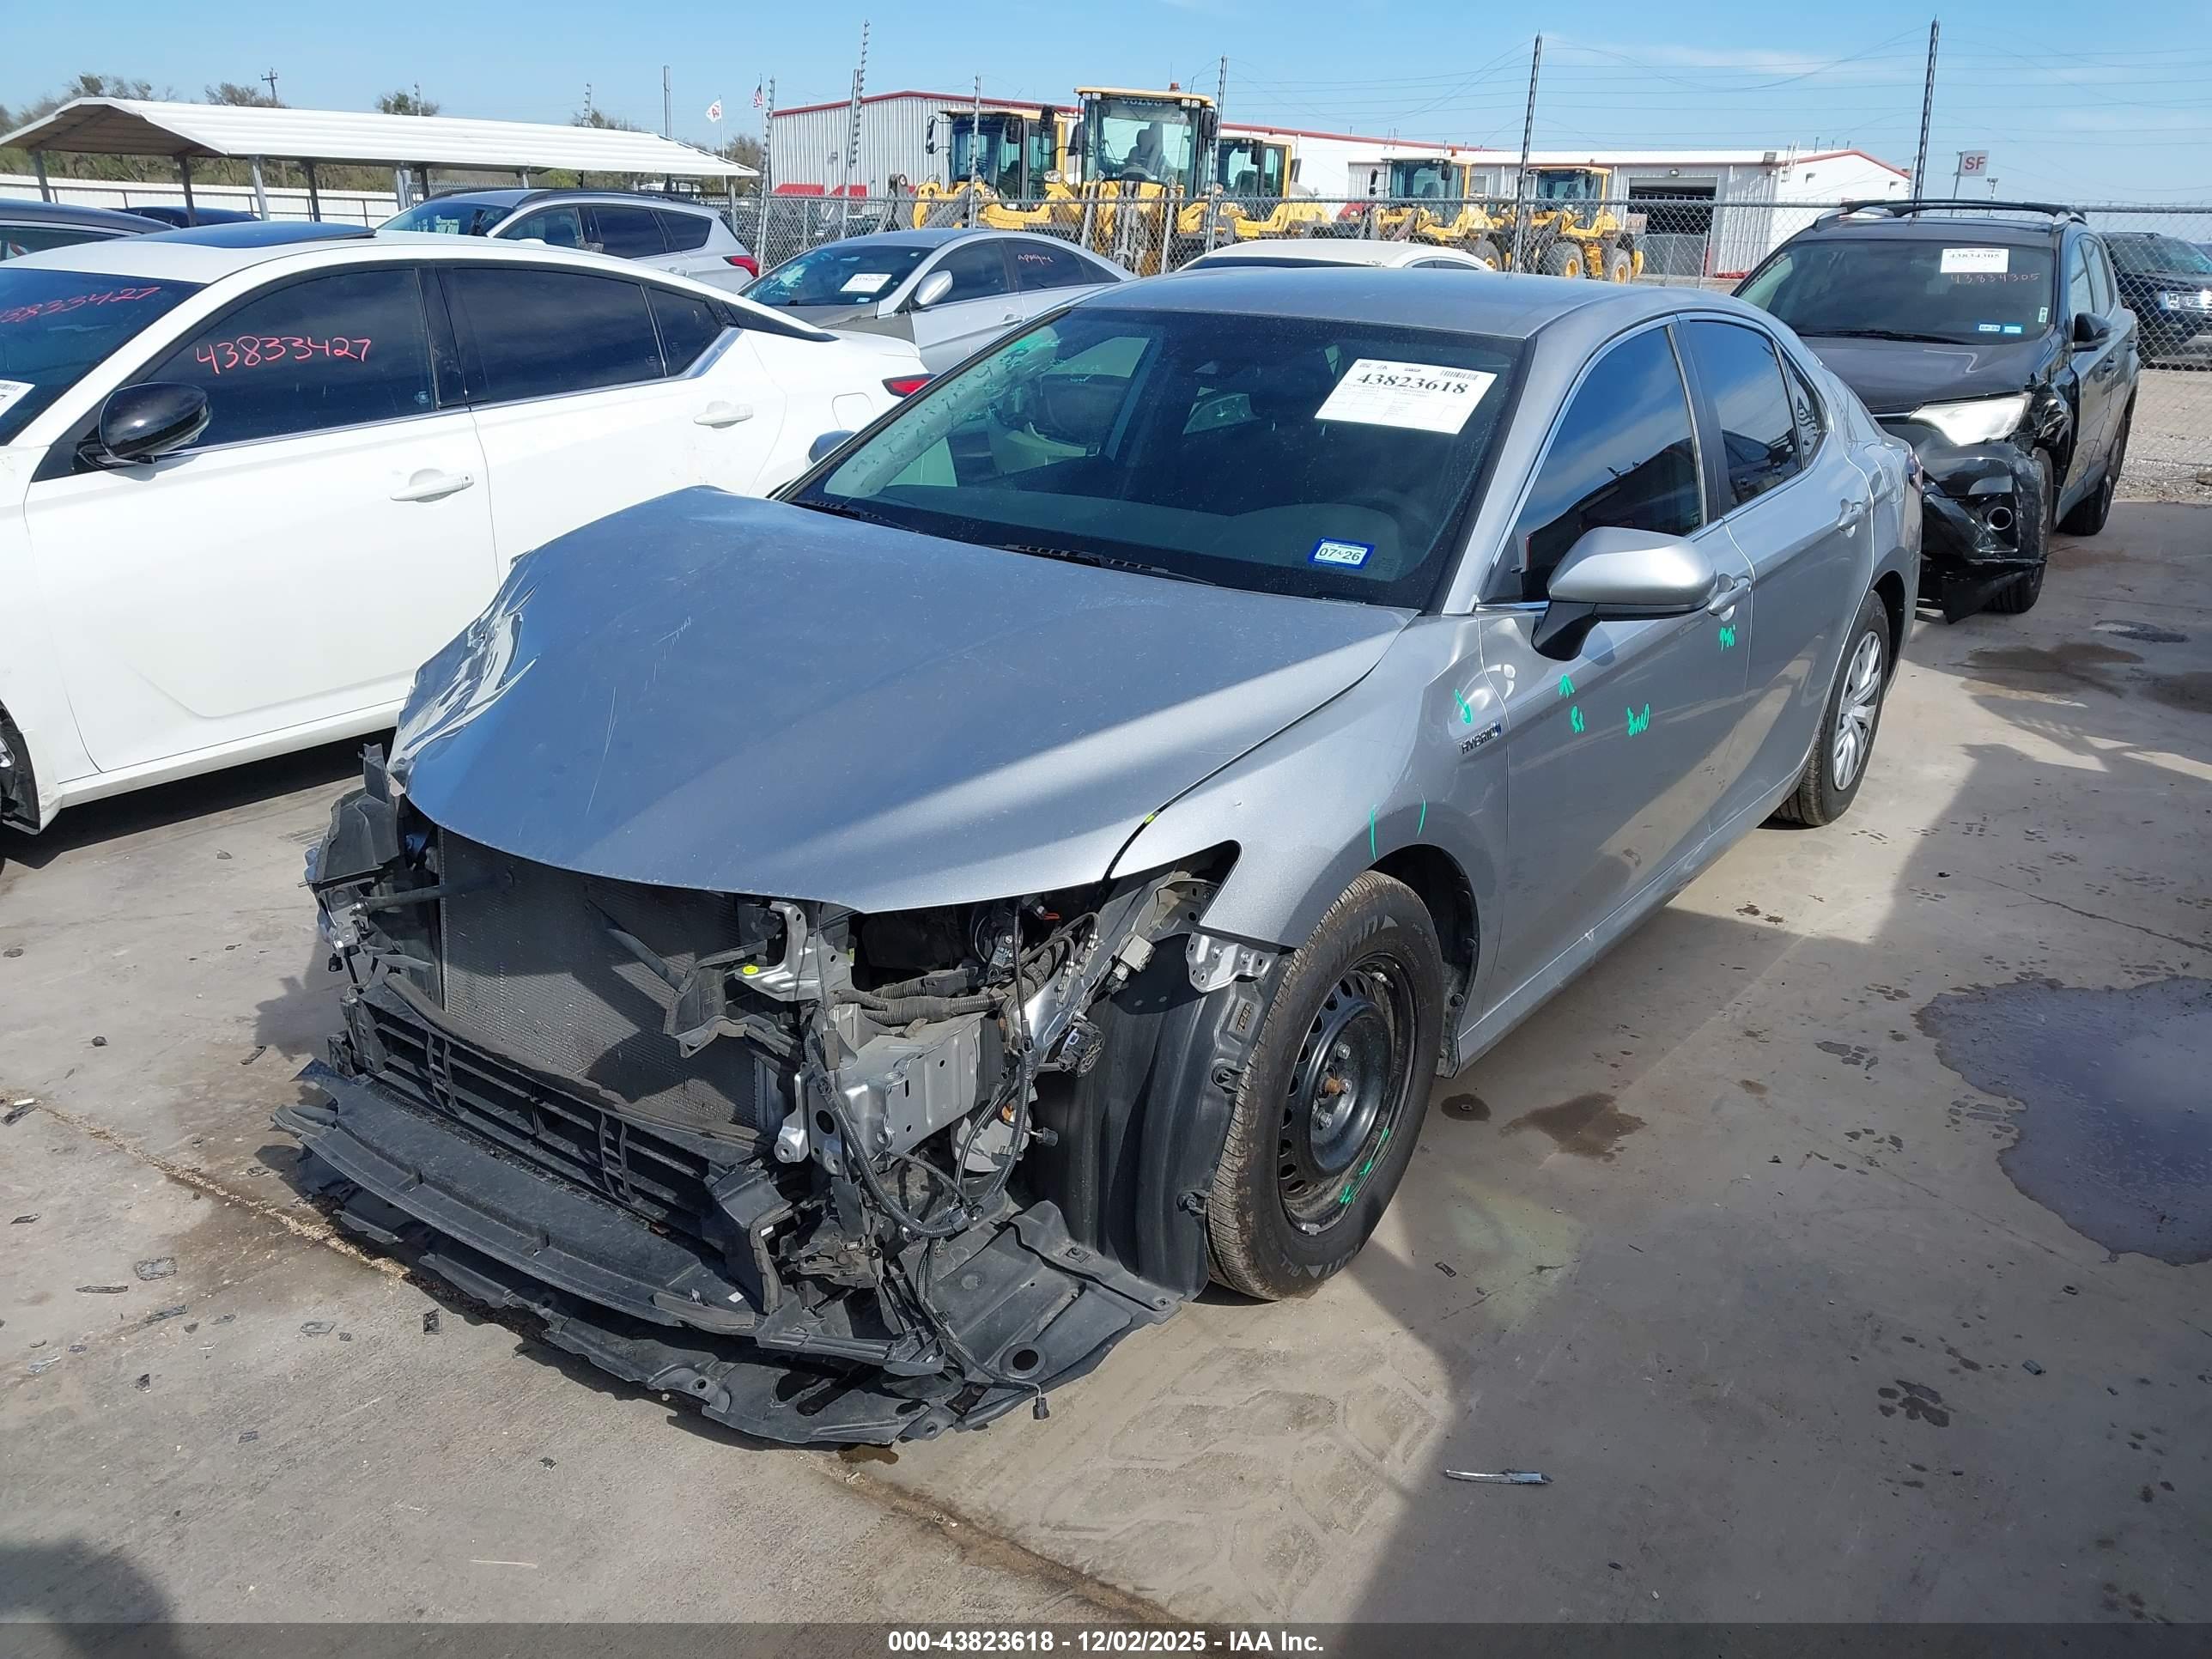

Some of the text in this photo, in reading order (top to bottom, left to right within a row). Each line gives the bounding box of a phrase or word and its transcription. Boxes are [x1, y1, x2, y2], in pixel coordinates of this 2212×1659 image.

[1964, 156, 1986, 170] SF
[1950, 272, 2041, 283] 43834305
[196, 336, 372, 375] 43833427
[1357, 373, 1468, 394] 43823618
[1461, 727, 1497, 755] HYBRID
